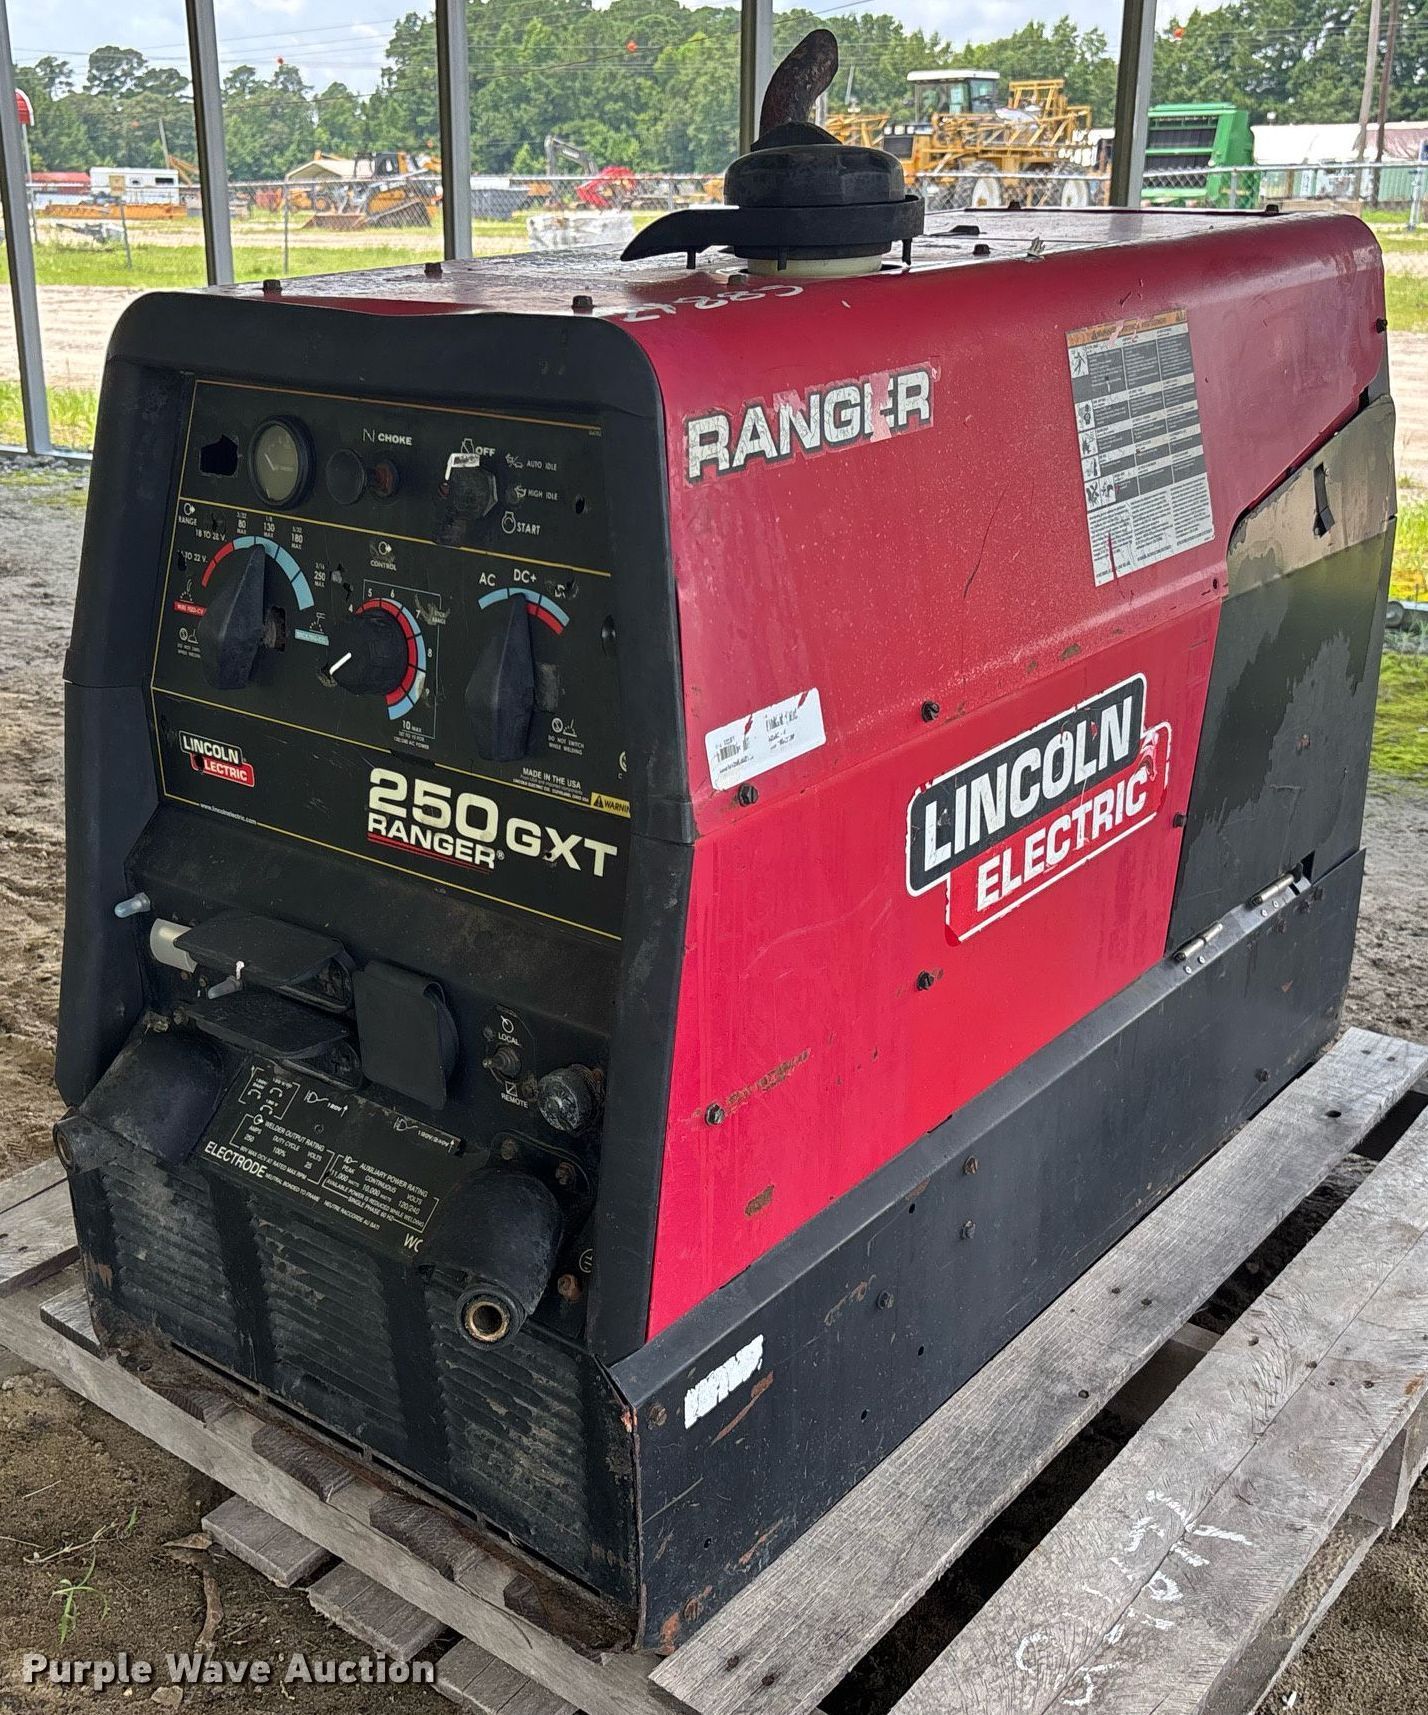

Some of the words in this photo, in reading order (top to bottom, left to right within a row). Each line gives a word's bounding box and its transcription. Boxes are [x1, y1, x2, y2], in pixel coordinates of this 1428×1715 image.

[378, 433, 412, 446] CHOKE
[475, 446, 496, 457] OFF
[526, 460, 542, 470] AUTO
[545, 462, 557, 471] IDLE
[528, 489, 542, 499] HIGH
[545, 491, 558, 500] IDLE
[238, 520, 246, 528] 80
[263, 522, 275, 532] 130
[516, 522, 541, 535] START
[203, 530, 211, 539] TO
[291, 533, 303, 544] 180
[291, 542, 302, 550] MAX
[194, 552, 202, 561] 22
[370, 560, 397, 571] CONTROL
[314, 571, 326, 582] 250
[479, 572, 496, 587] AC
[513, 568, 537, 584] DC+
[314, 580, 325, 588] MAX
[368, 588, 372, 598] 5
[390, 589, 395, 598] 6
[348, 604, 354, 612] 4
[416, 610, 420, 619] 7
[427, 648, 432, 658] 8
[402, 720, 410, 730] 10
[557, 736, 566, 744] NOT
[568, 738, 584, 749] SWITCH
[183, 735, 239, 764] LINCOLN
[202, 756, 248, 781] LECTRIC
[522, 767, 542, 779] MADE
[544, 772, 550, 781] IN
[551, 774, 566, 786] THE
[566, 778, 582, 790] USA
[924, 695, 1132, 872] LINCOLN
[368, 768, 499, 842] 250
[505, 817, 618, 877] GXT
[977, 770, 1148, 911] ELECTRIC
[498, 1032, 520, 1046] LOCAL
[501, 1092, 528, 1109] REMOTE
[265, 1121, 286, 1134] WELDER
[286, 1130, 306, 1143] OUTPUT
[306, 1139, 324, 1152] RATING
[248, 1125, 262, 1134] AMPS
[272, 1135, 284, 1144] DUTY
[285, 1140, 300, 1151] CYCLE
[307, 1152, 322, 1162] VOLTS
[272, 1147, 286, 1157] 100%
[204, 1141, 268, 1178] ELECTRODE
[248, 1148, 257, 1156] MAX
[272, 1159, 287, 1170] RATED
[288, 1166, 296, 1175] MAX
[296, 1170, 307, 1180] RPM
[342, 1164, 356, 1174] PEAK
[364, 1175, 398, 1194] CONTINUOUS
[406, 1194, 422, 1205] VOLTS
[360, 1163, 388, 1179] AUXILIARY
[388, 1174, 408, 1188] POWER
[408, 1184, 428, 1198] RATING
[306, 1192, 320, 1202] FRAME
[326, 1179, 349, 1192] AVAILABLE
[349, 1188, 364, 1200] POWER
[369, 1198, 390, 1211] REDUCED
[390, 1206, 404, 1218] WHILE
[404, 1212, 424, 1228] WELDING
[348, 1196, 364, 1208] SINGLE
[364, 1203, 380, 1216] PHASE
